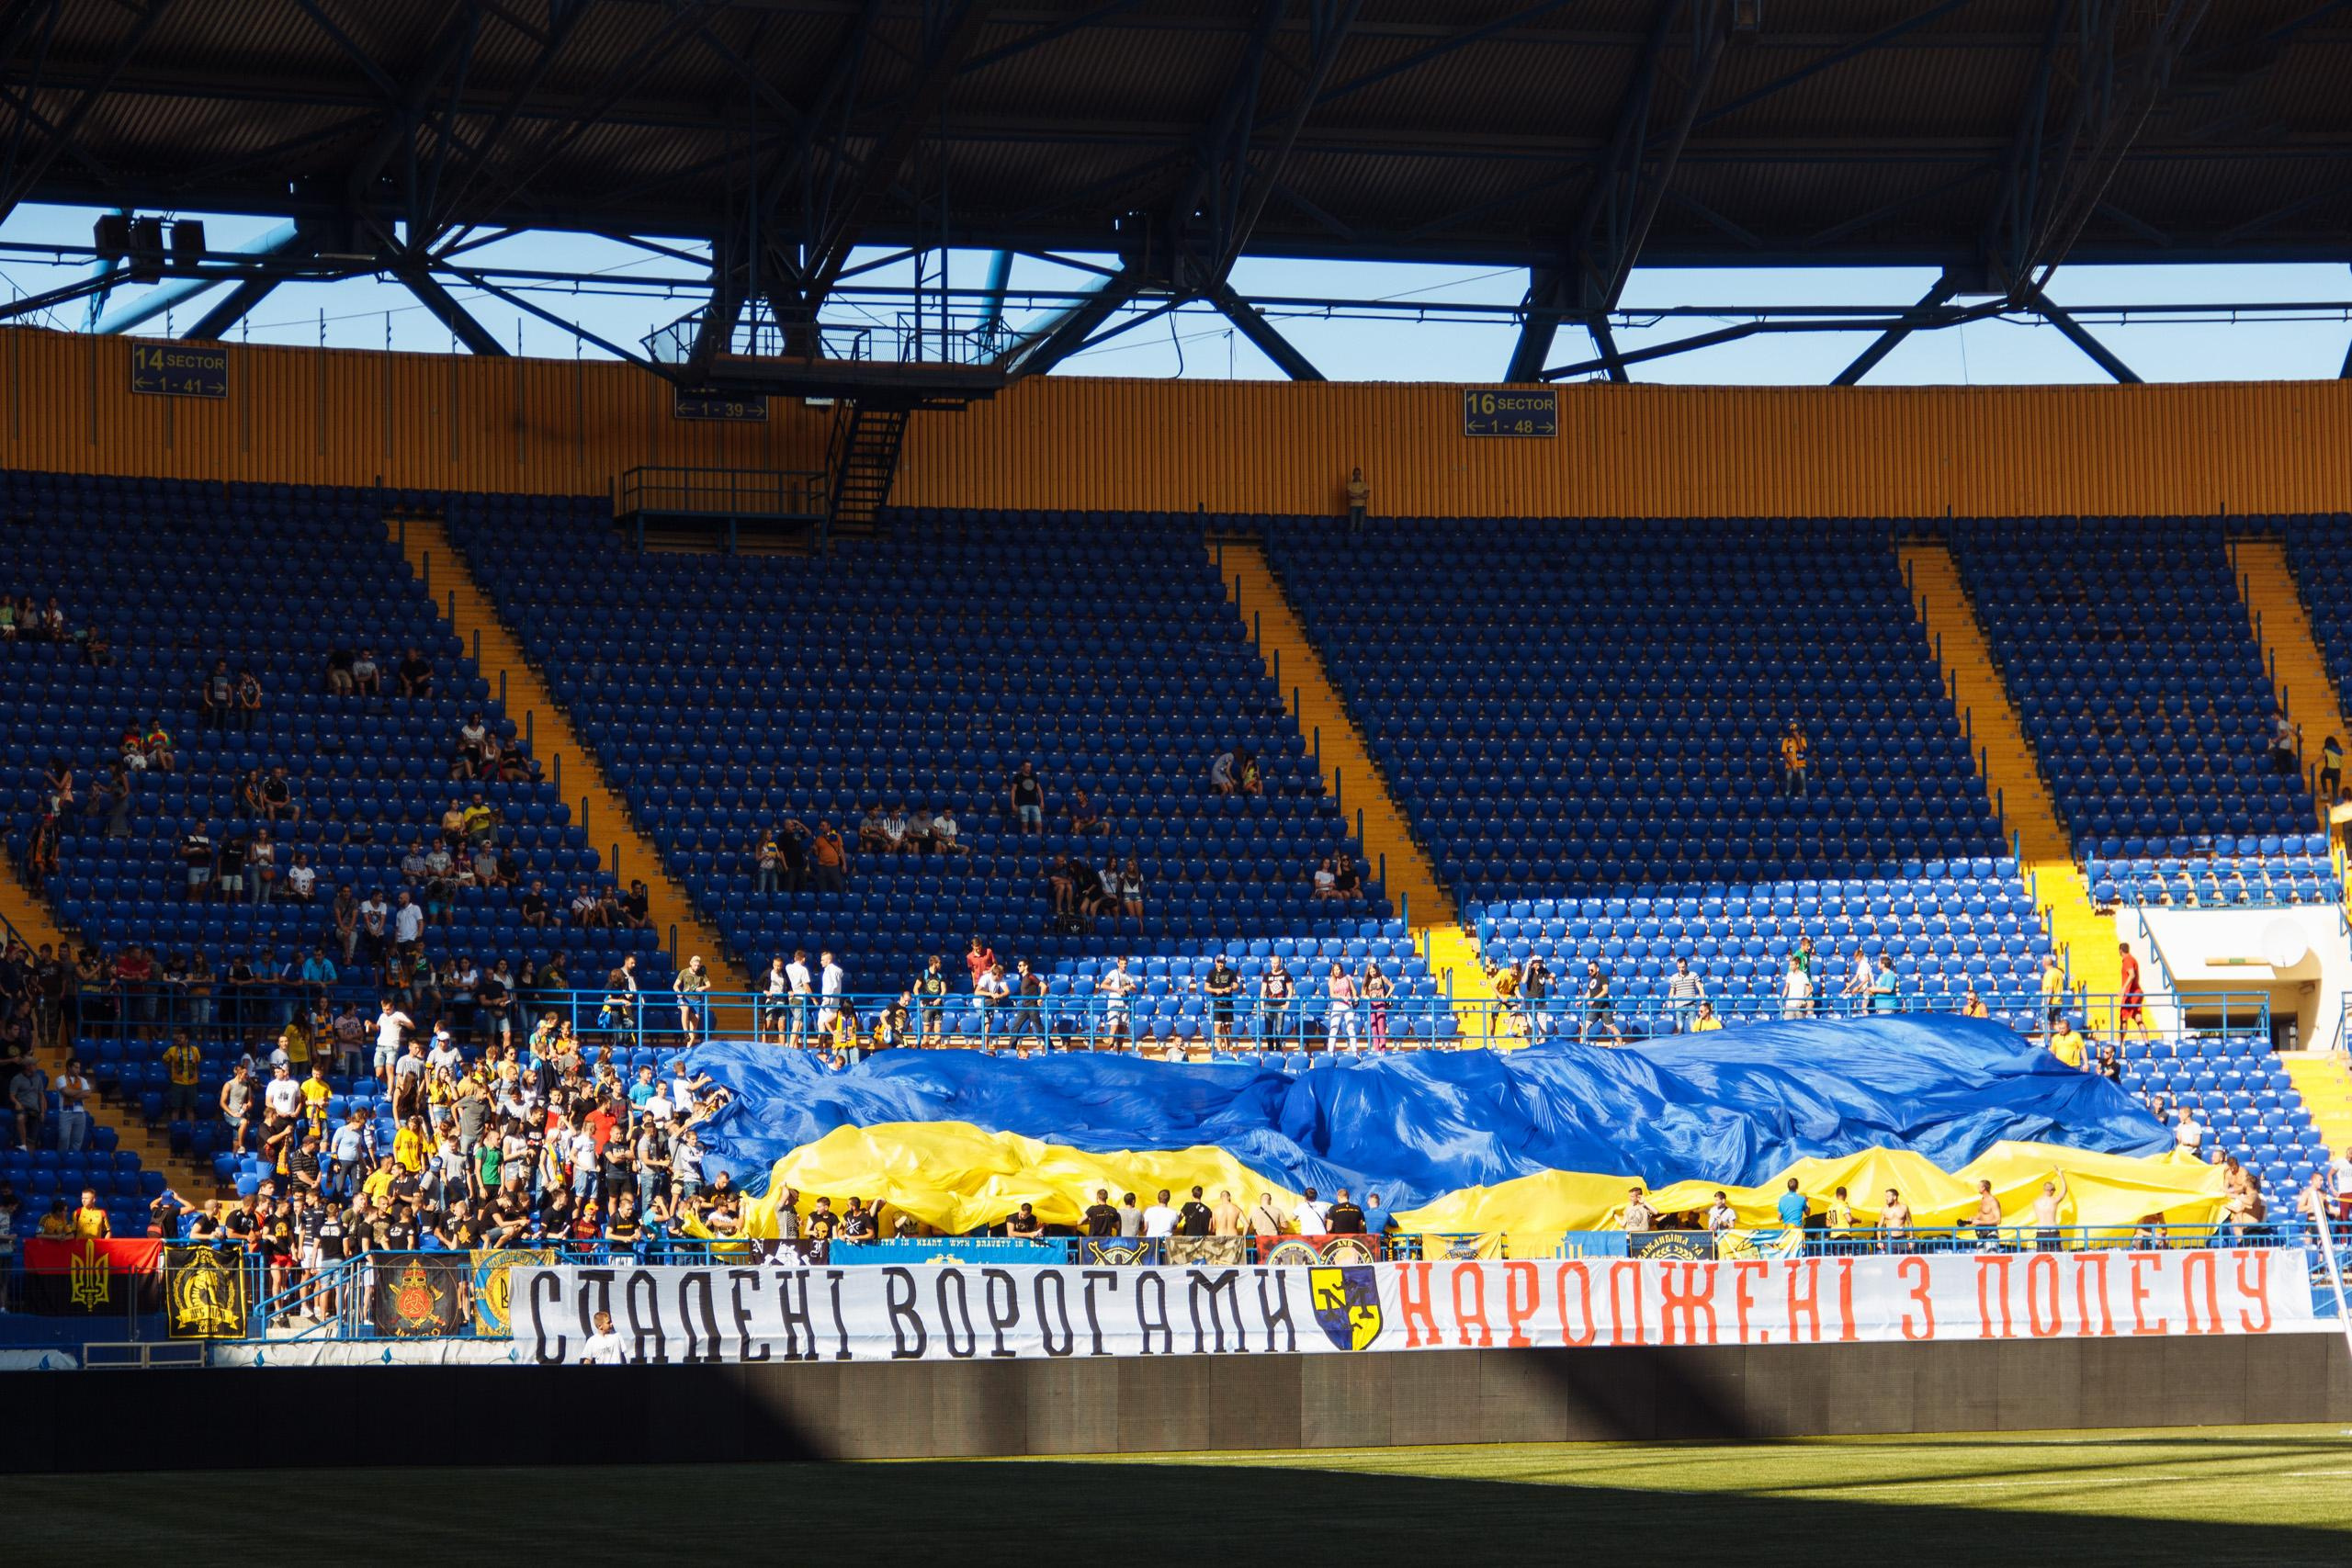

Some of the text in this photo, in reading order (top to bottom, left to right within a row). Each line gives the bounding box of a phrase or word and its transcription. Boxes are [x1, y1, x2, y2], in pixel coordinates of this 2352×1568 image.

[134, 347, 224, 372] 14 SECTOR
[159, 377, 167, 391] 1
[183, 378, 203, 393] 41
[701, 401, 709, 416] 1
[725, 402, 744, 417] 39
[1467, 392, 1554, 415] 16 SECTOR
[1491, 419, 1498, 434] 1
[1514, 420, 1533, 434] 48
[1336, 1240, 1353, 1248] AND
[1395, 1250, 2271, 1348] НАРОДЖЕНІ З ПОПЕЛУ
[529, 1266, 1301, 1365] СПАЛЕНІ ВОРОГАМИ
